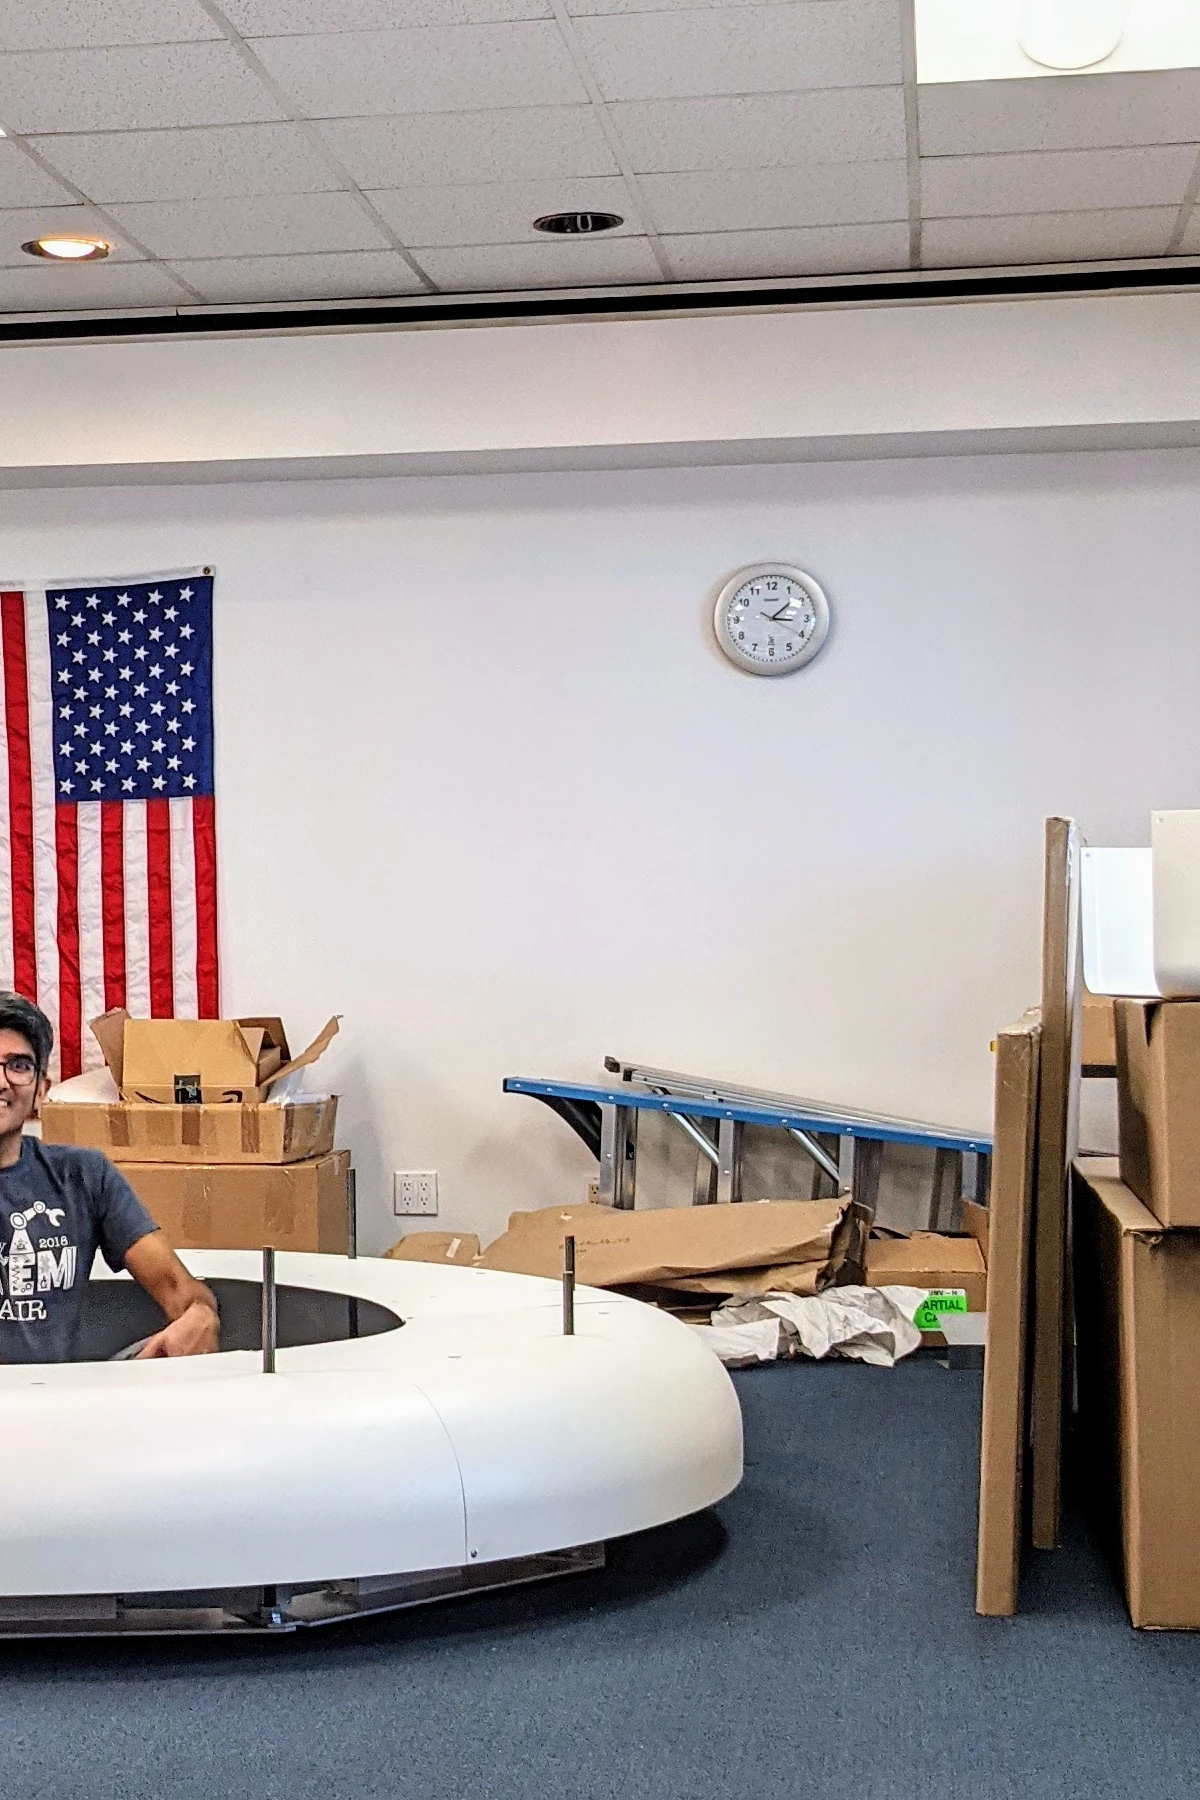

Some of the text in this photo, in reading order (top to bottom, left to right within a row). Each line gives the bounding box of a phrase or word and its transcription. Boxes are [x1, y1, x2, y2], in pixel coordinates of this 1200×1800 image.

[766, 582, 778, 590] 12
[786, 586, 791, 594] 1
[749, 587, 760, 595] 11
[738, 598, 750, 607] 10
[804, 614, 810, 623] 3
[738, 631, 745, 640] 8
[798, 630, 805, 638] 4
[752, 643, 758, 652] 7
[768, 648, 775, 656] 6
[786, 643, 793, 652] 5
[39, 1236, 68, 1249] 2018
[921, 1299, 963, 1310] ARTIAL
